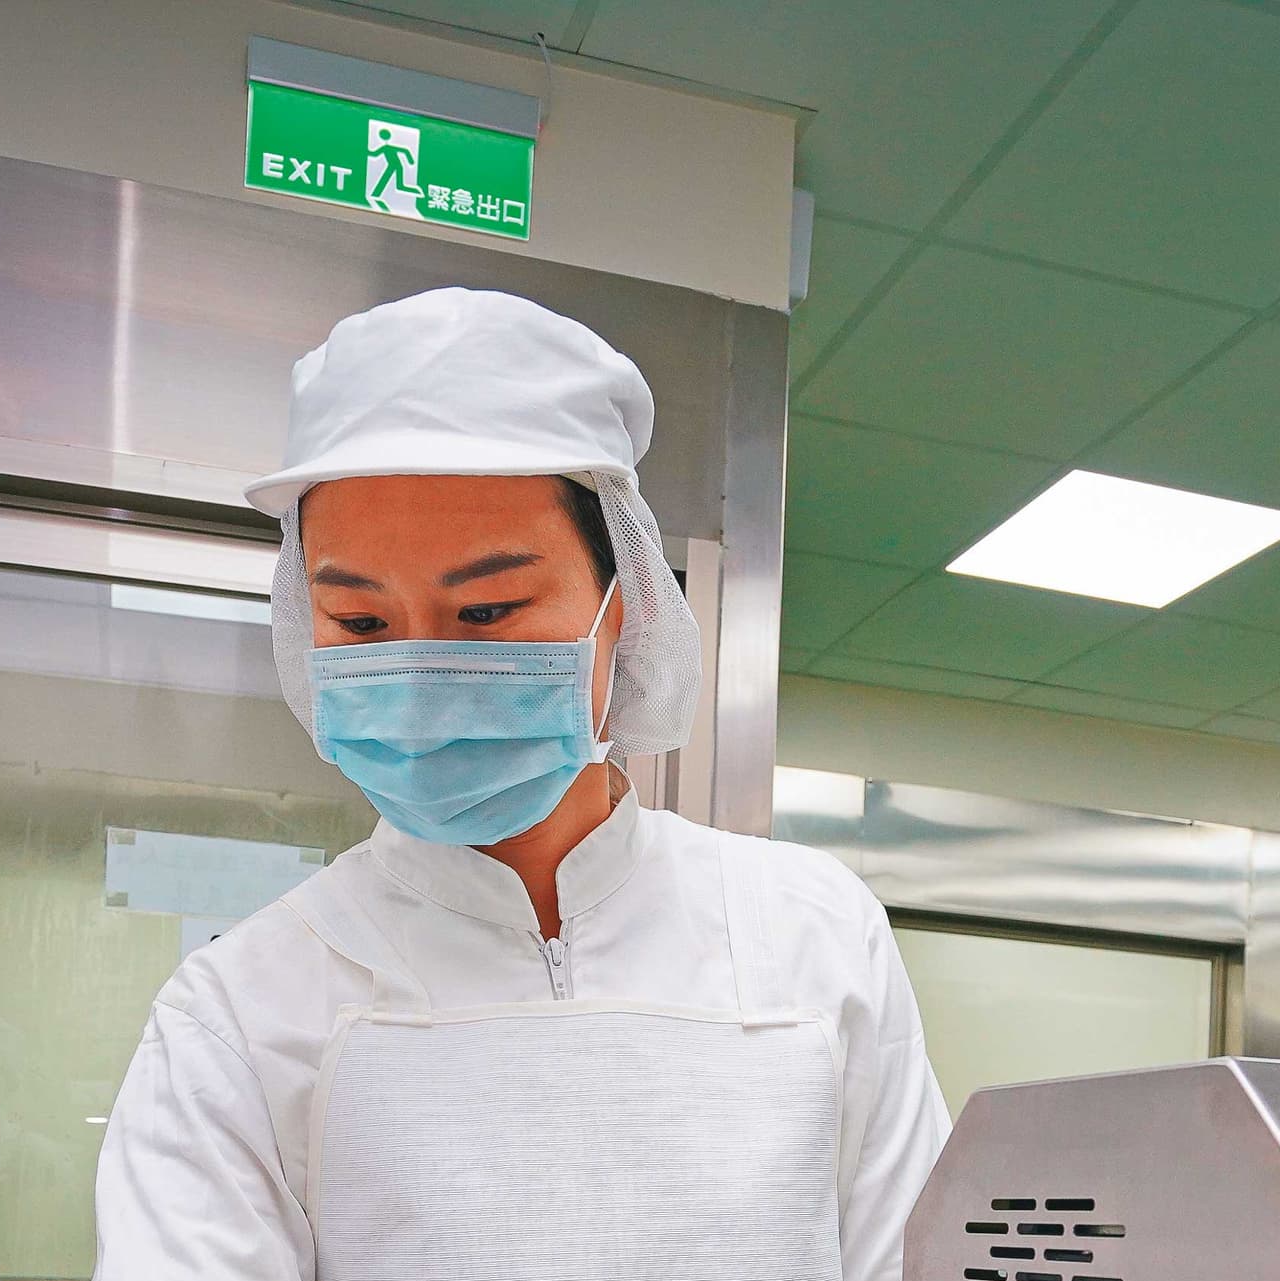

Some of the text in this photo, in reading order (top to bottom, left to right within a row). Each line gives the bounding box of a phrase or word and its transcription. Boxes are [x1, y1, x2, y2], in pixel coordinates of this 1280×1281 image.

[262, 152, 352, 191] EXIT
[427, 184, 526, 226] 緊急出口
